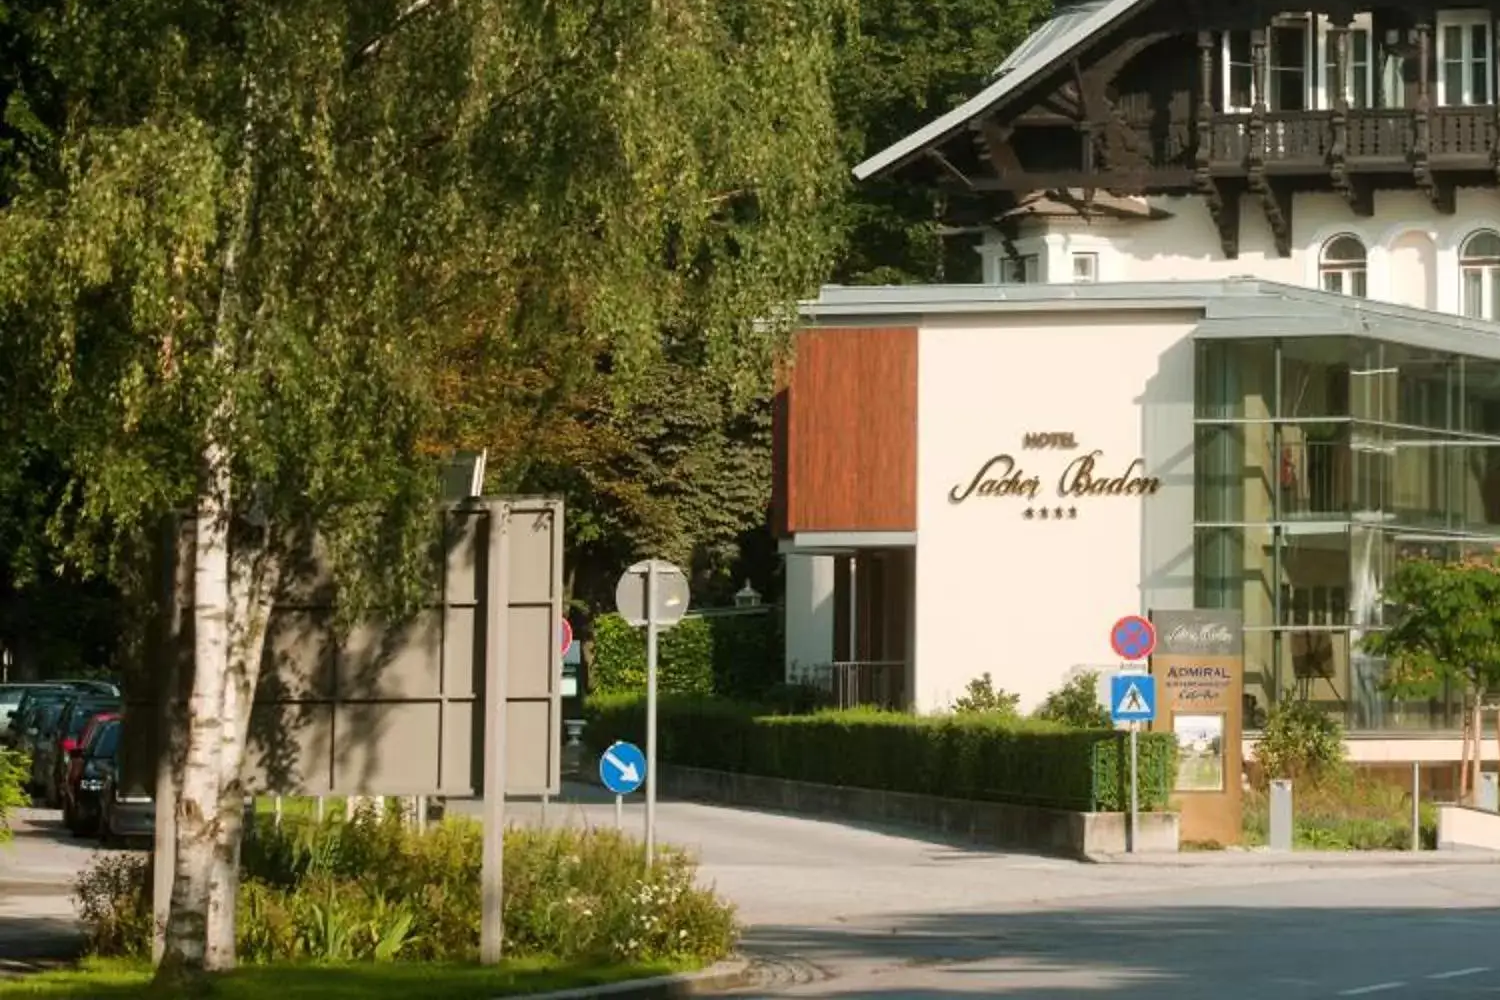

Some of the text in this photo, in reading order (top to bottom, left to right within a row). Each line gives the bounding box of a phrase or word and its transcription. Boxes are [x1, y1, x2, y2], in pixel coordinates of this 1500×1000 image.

[1022, 432, 1078, 449] HOTEL
[949, 450, 1162, 505] Sacher Baden
[1167, 667, 1231, 679] ADMIRAL
